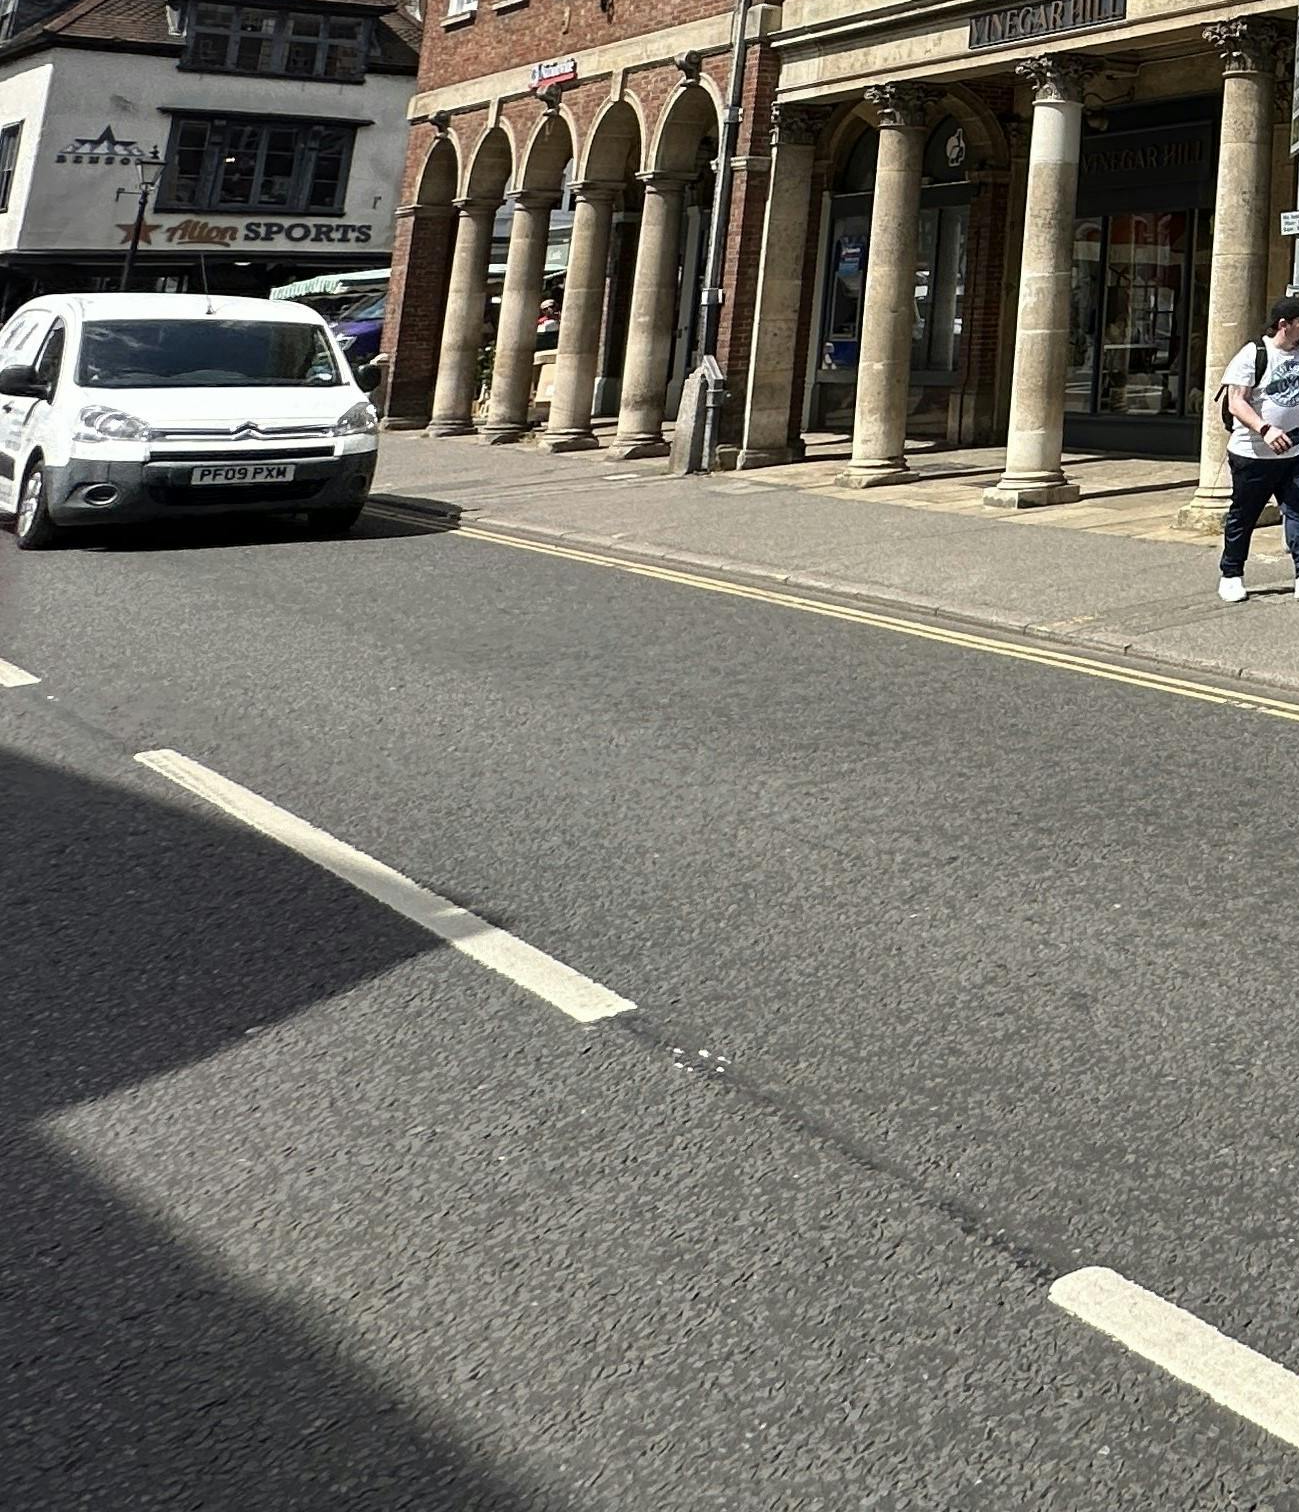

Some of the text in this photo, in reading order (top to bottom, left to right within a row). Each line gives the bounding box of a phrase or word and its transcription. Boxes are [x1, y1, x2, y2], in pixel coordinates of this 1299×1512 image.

[971, 0, 1064, 45] VINEGAR
[55, 155, 139, 166] BENSO
[165, 219, 373, 243] Alton SPORTS
[200, 467, 248, 481] PF09
